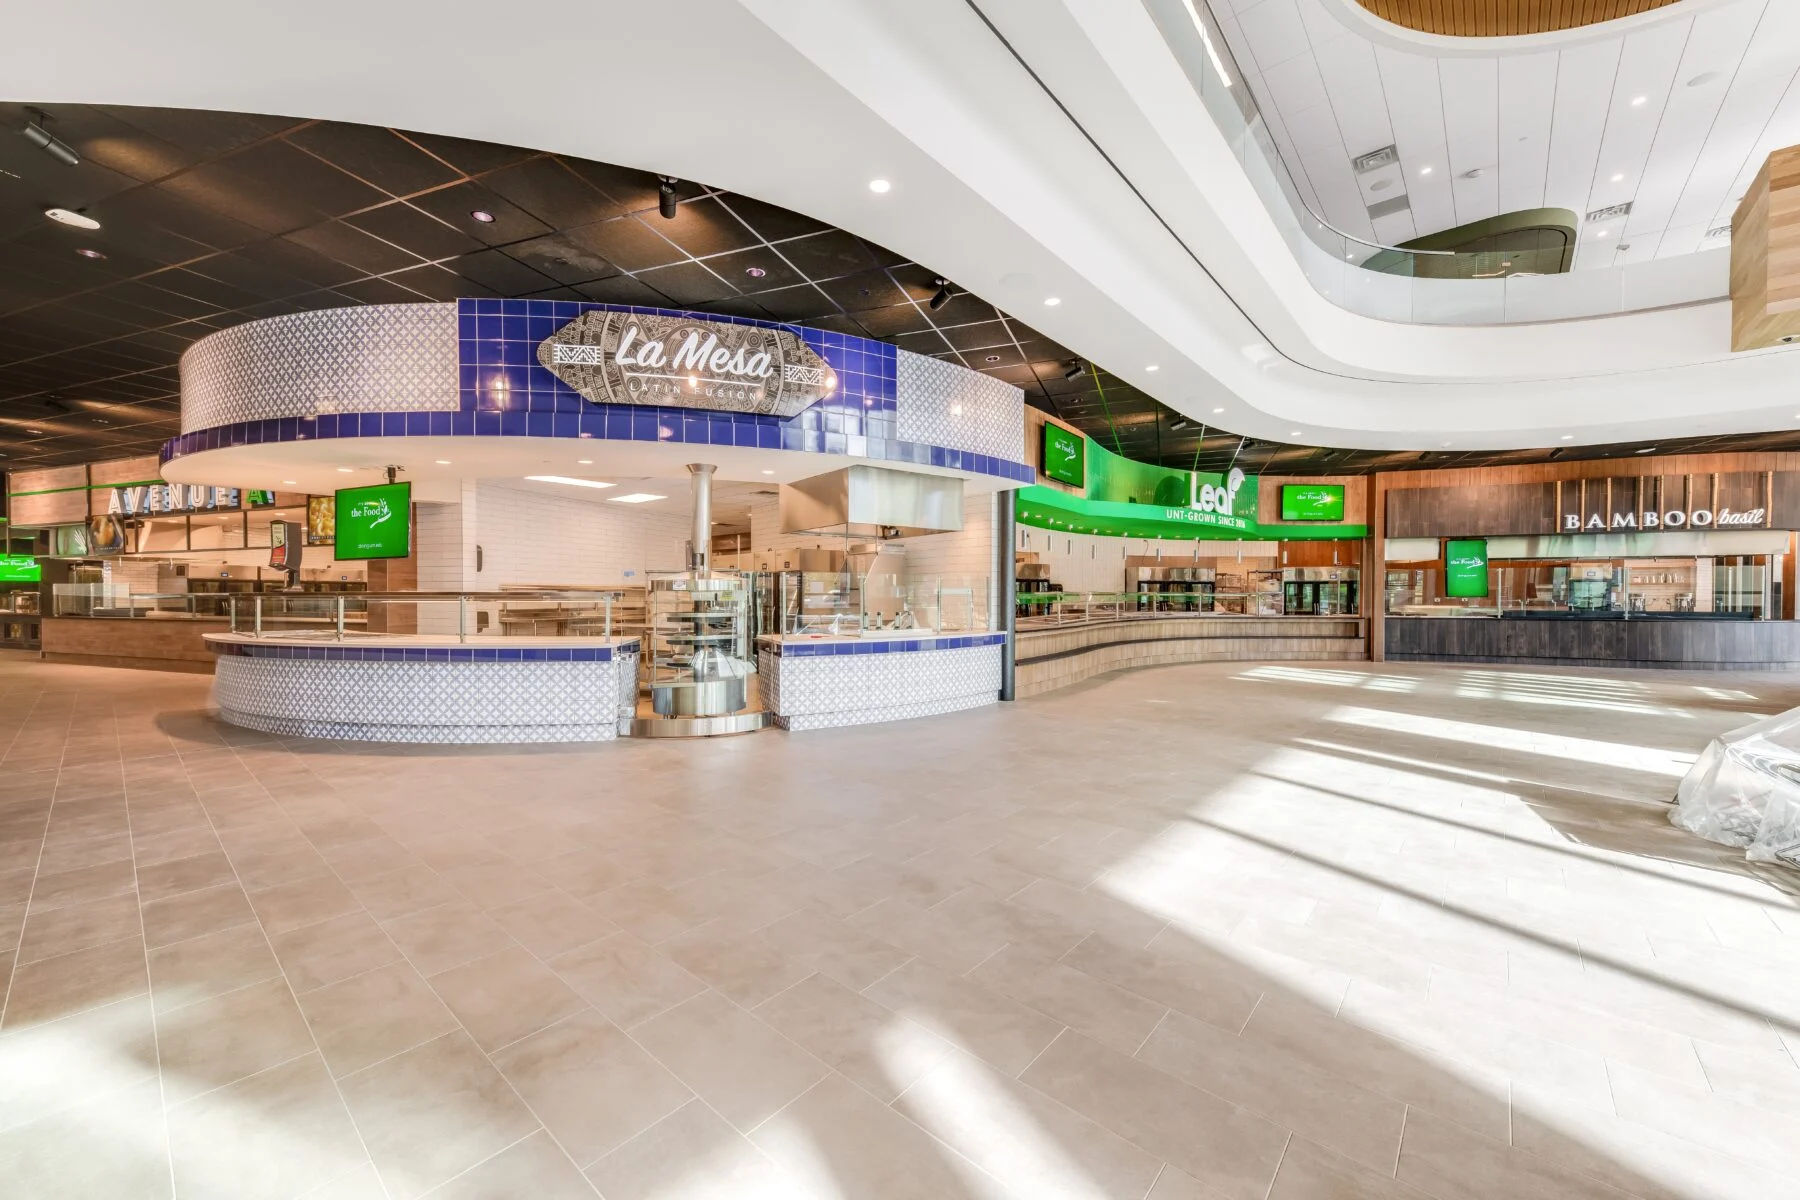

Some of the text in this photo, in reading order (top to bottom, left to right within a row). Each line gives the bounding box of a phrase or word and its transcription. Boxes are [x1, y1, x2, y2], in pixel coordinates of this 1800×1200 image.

[615, 326, 774, 378] La Mesa
[630, 383, 756, 401] LATIN FUSION
[107, 483, 229, 515] AVENUE
[1191, 467, 1246, 516] Leaf
[351, 506, 381, 518] the Food
[1166, 508, 1216, 524] UNT-GROWN
[1218, 515, 1235, 527] SINCE
[1565, 507, 1766, 529] BAMBOO basil
